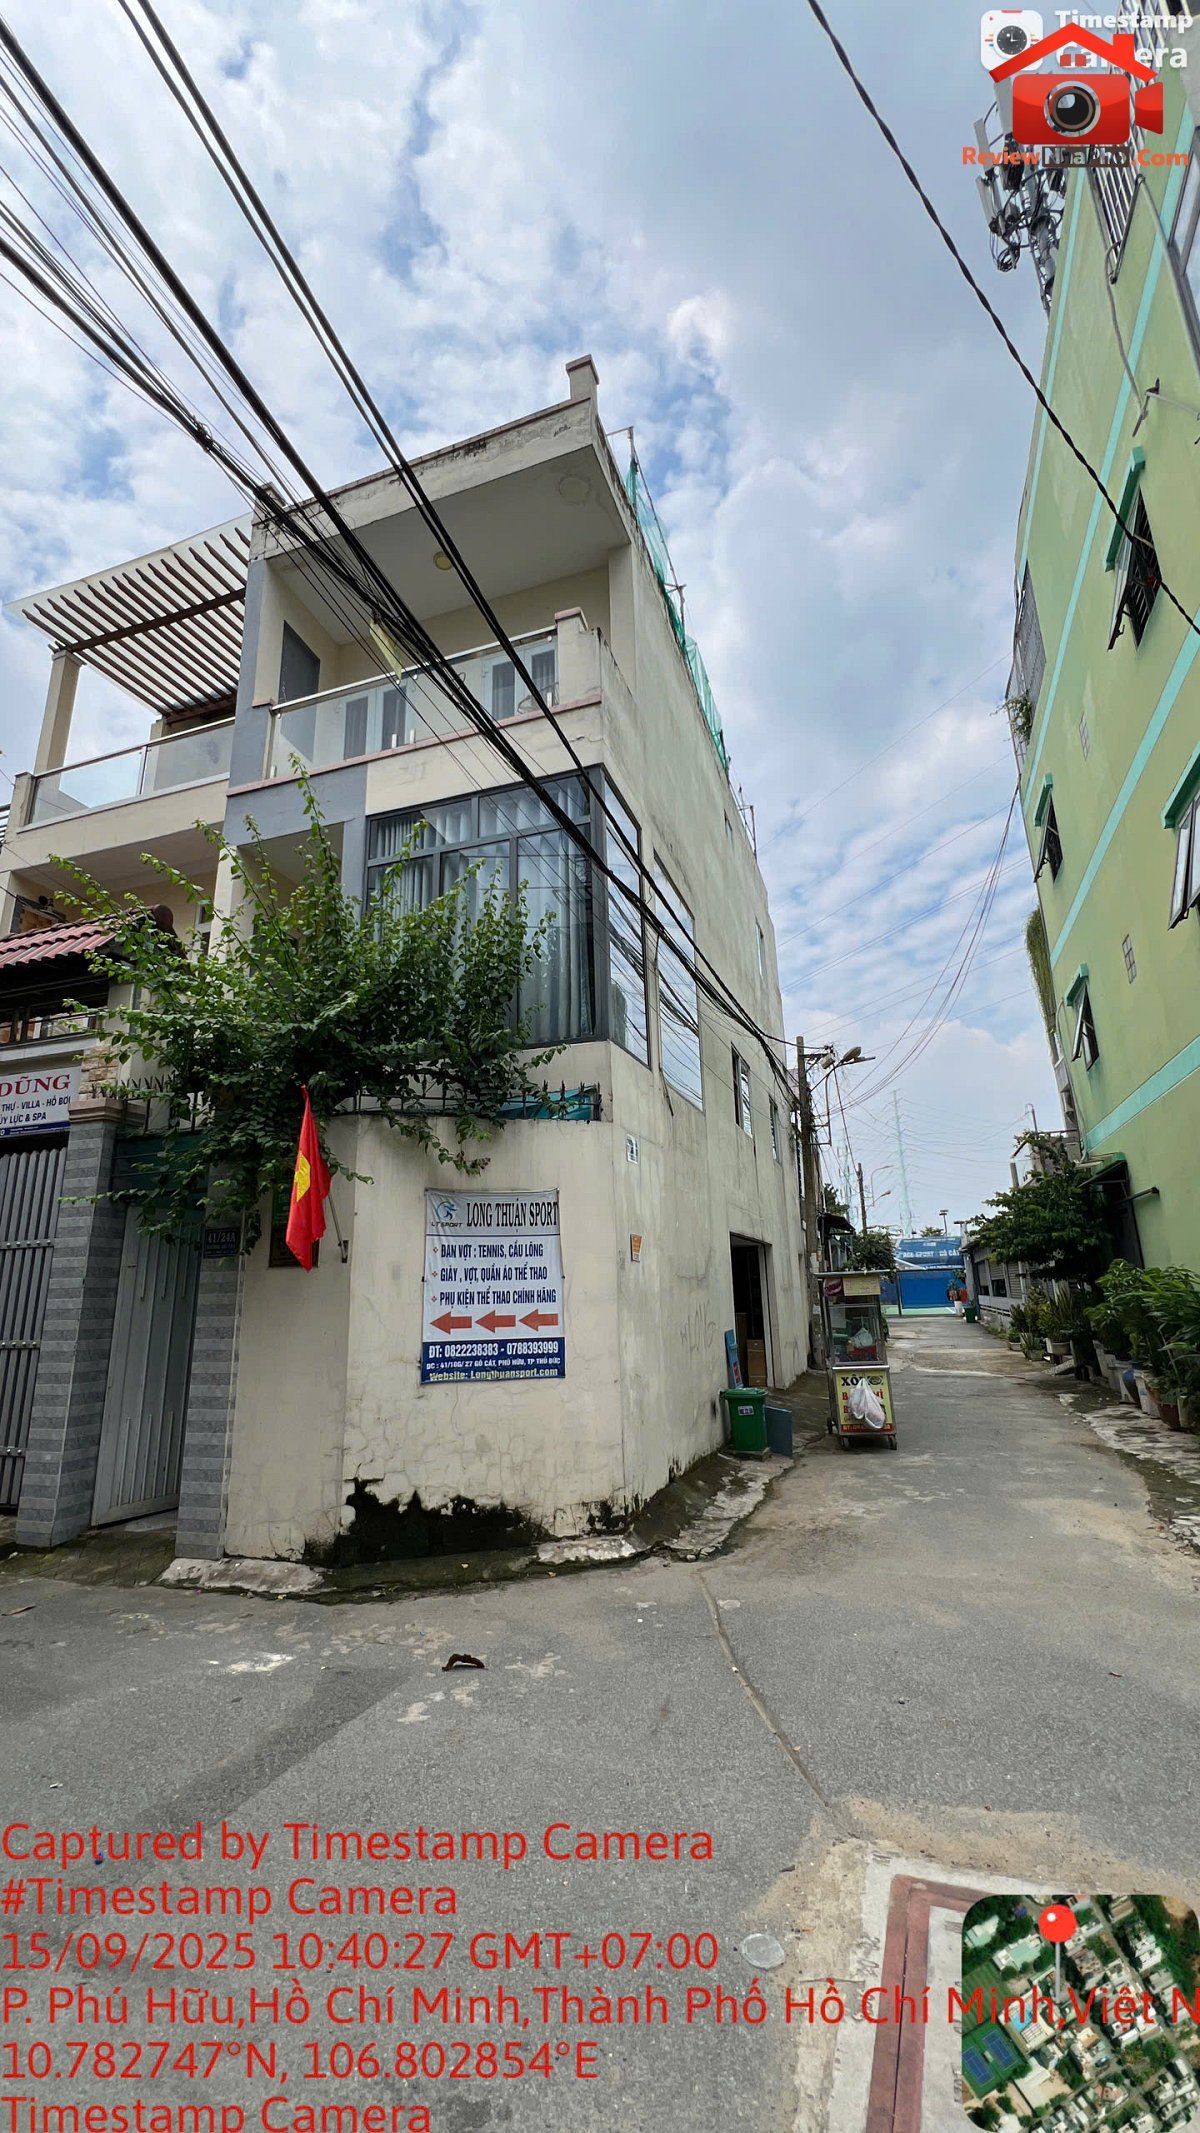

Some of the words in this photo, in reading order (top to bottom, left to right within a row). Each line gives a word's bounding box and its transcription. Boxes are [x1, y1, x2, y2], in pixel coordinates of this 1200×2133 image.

[0, 1074, 71, 1097] DŨNG
[21, 1100, 40, 1110] VILLA
[25, 1114, 30, 1122] &
[32, 1112, 47, 1121] SPA
[467, 1202, 493, 1228] LONG
[495, 1198, 527, 1233] THUẬN
[529, 1201, 558, 1228] SPORT
[441, 1244, 457, 1258] ĐAN
[458, 1243, 472, 1261] VỢT
[478, 1244, 507, 1259] TENNIS,
[525, 1243, 544, 1257] LÔNG
[440, 1265, 459, 1282] GIÀY
[464, 1265, 480, 1285] VỢT,
[502, 1265, 513, 1281] ÁO
[514, 1261, 528, 1281] THỂ
[529, 1266, 548, 1280] THAO
[440, 1291, 455, 1309] PHỤ
[457, 1288, 475, 1309] KIỆN
[476, 1285, 491, 1305] THỂ
[492, 1291, 511, 1304] THAO
[513, 1287, 535, 1304] CHÍNH
[429, 1345, 443, 1358] ĐT:
[444, 1343, 499, 1358] 0822238383
[506, 1341, 559, 1355] 0788393999
[429, 1371, 468, 1381] Website:
[470, 1367, 558, 1380] Longthuansport.com
